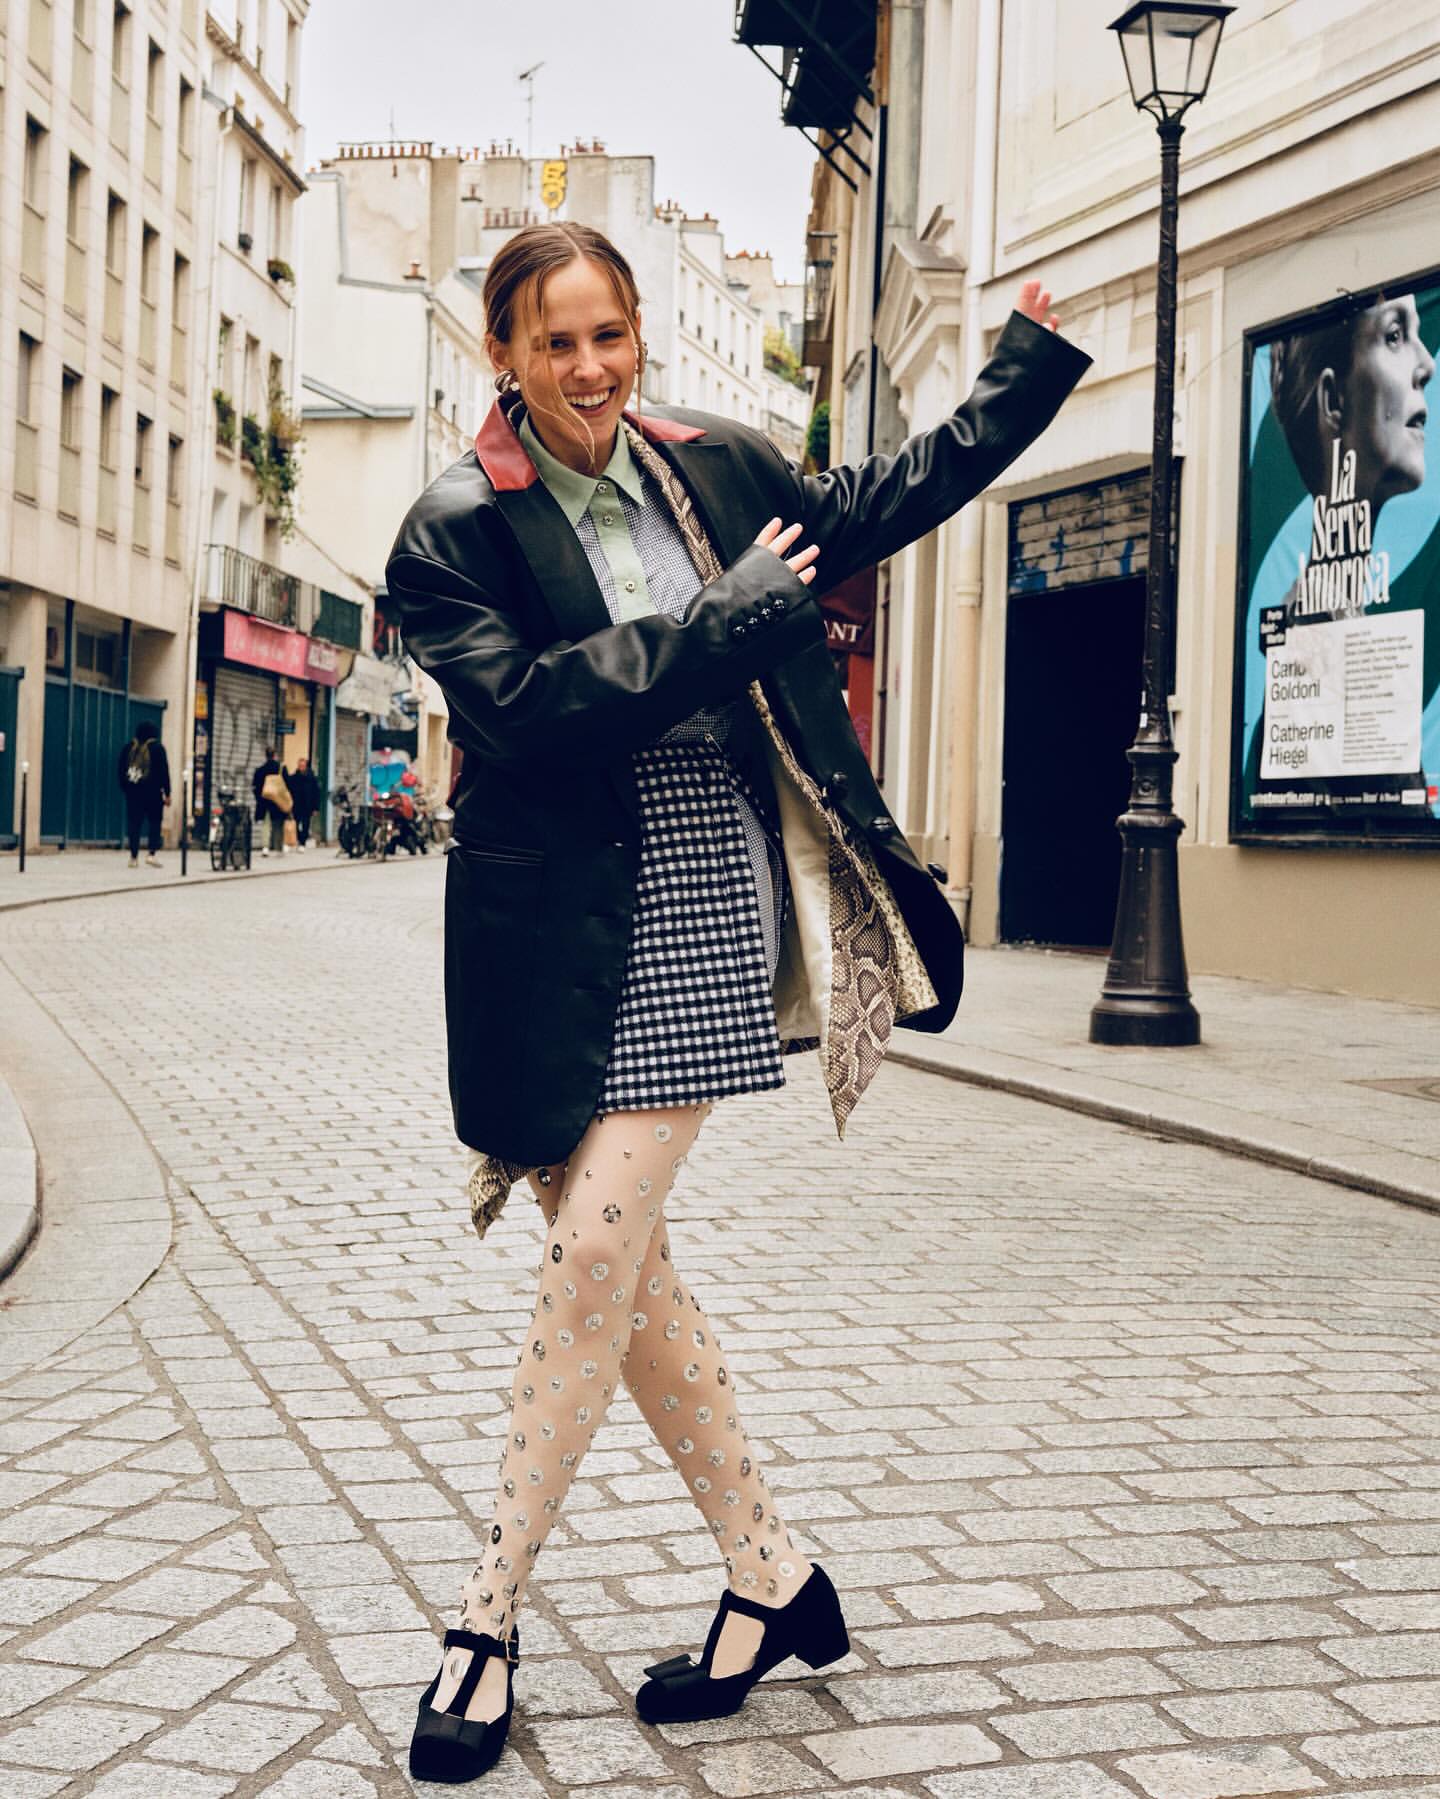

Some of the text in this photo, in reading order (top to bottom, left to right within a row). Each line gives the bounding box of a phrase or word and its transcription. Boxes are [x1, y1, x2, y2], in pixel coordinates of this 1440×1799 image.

[1330, 438, 1357, 504] La
[1311, 495, 1372, 560] Serva
[1295, 551, 1390, 616] Amorosa
[1271, 679, 1321, 702] Goldoni
[1270, 720, 1335, 743] Catherine
[1269, 744, 1309, 769] Hiegel
